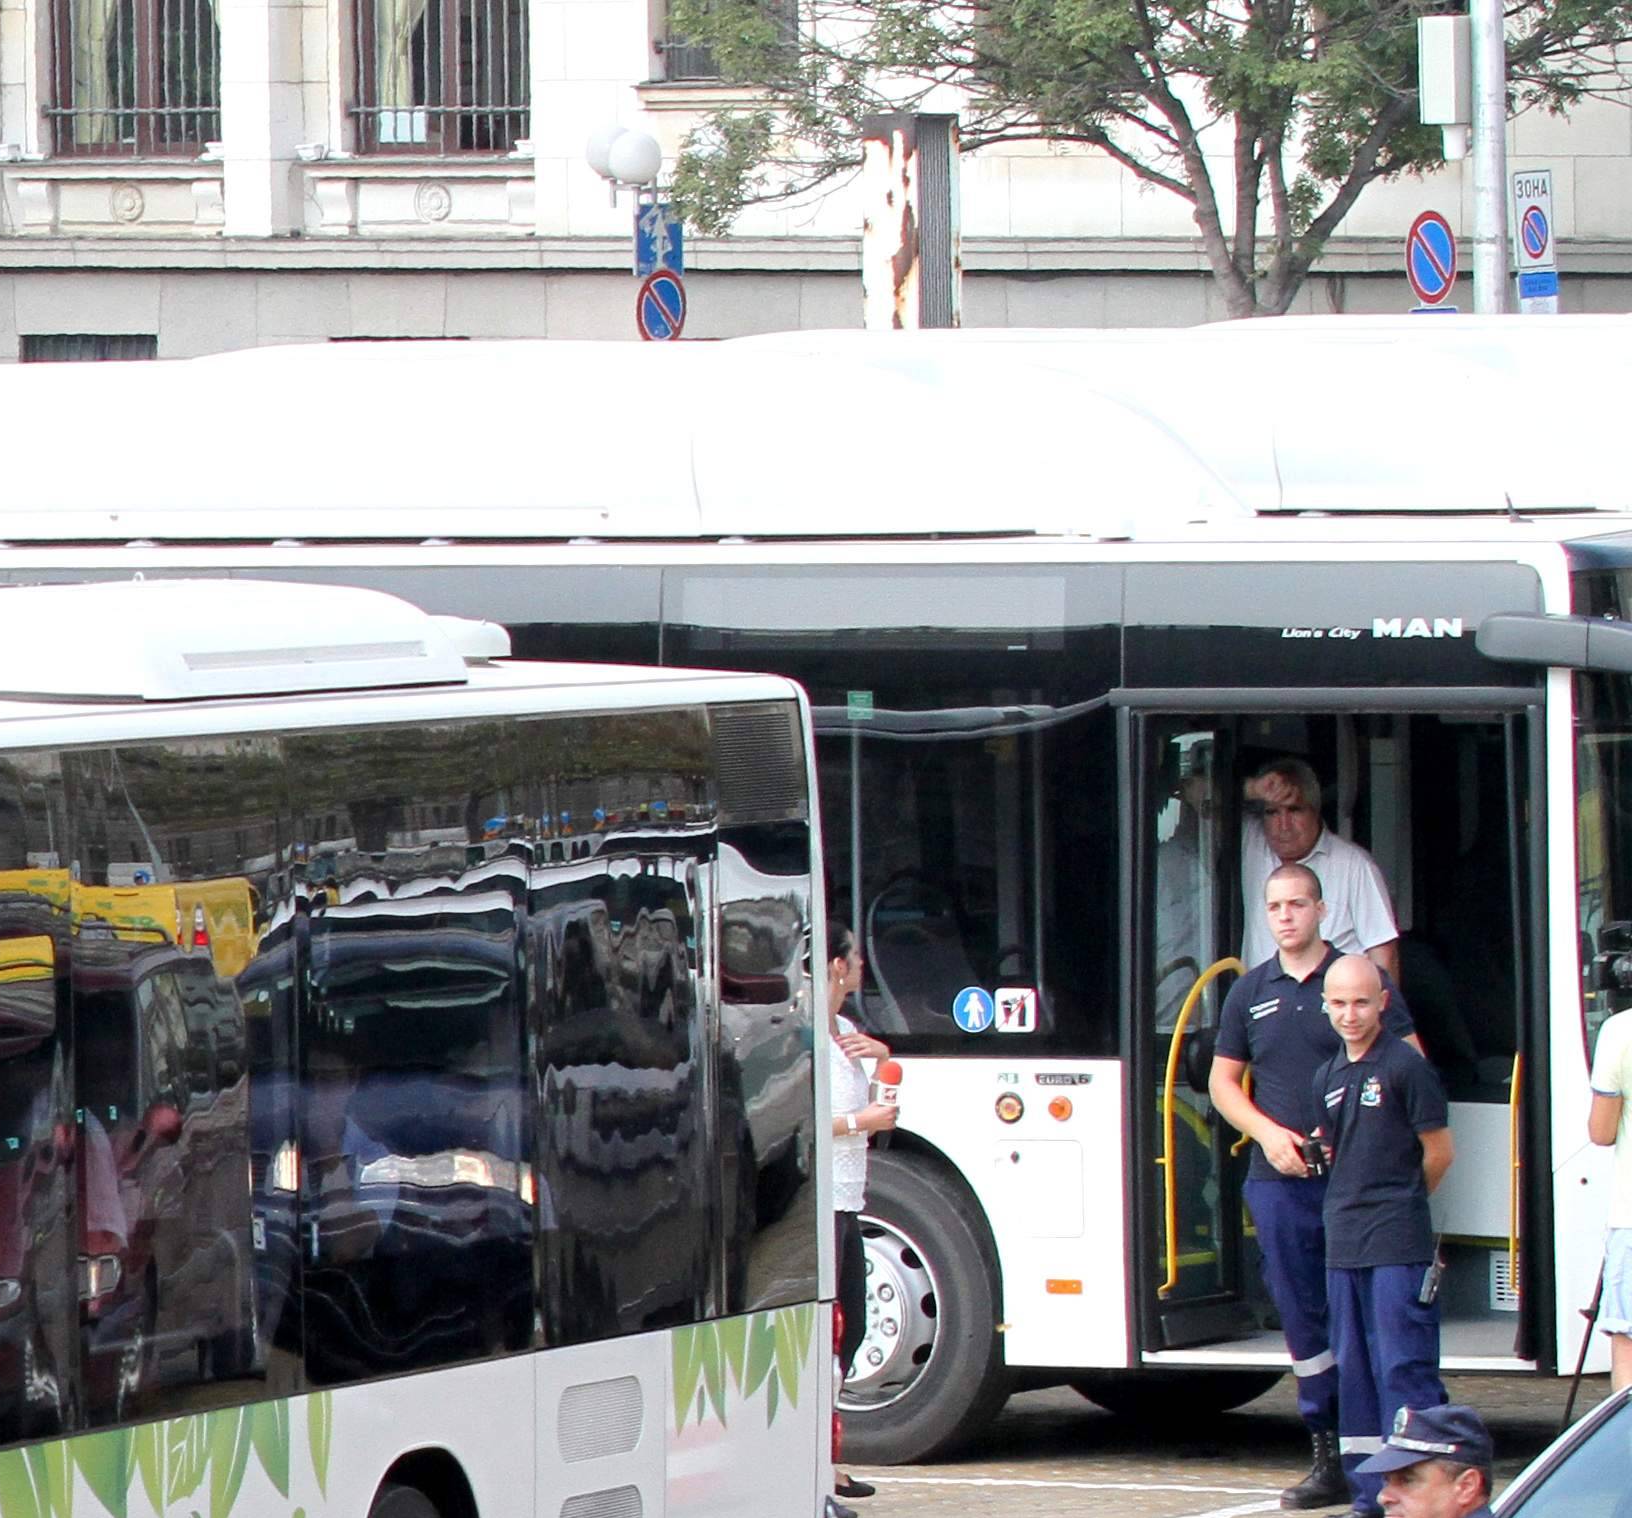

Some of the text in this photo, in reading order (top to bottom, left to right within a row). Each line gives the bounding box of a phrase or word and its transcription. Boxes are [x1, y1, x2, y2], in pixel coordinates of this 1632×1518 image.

[1516, 178, 1548, 199] ЗОНА
[1281, 617, 1463, 640] Lion's City MAN
